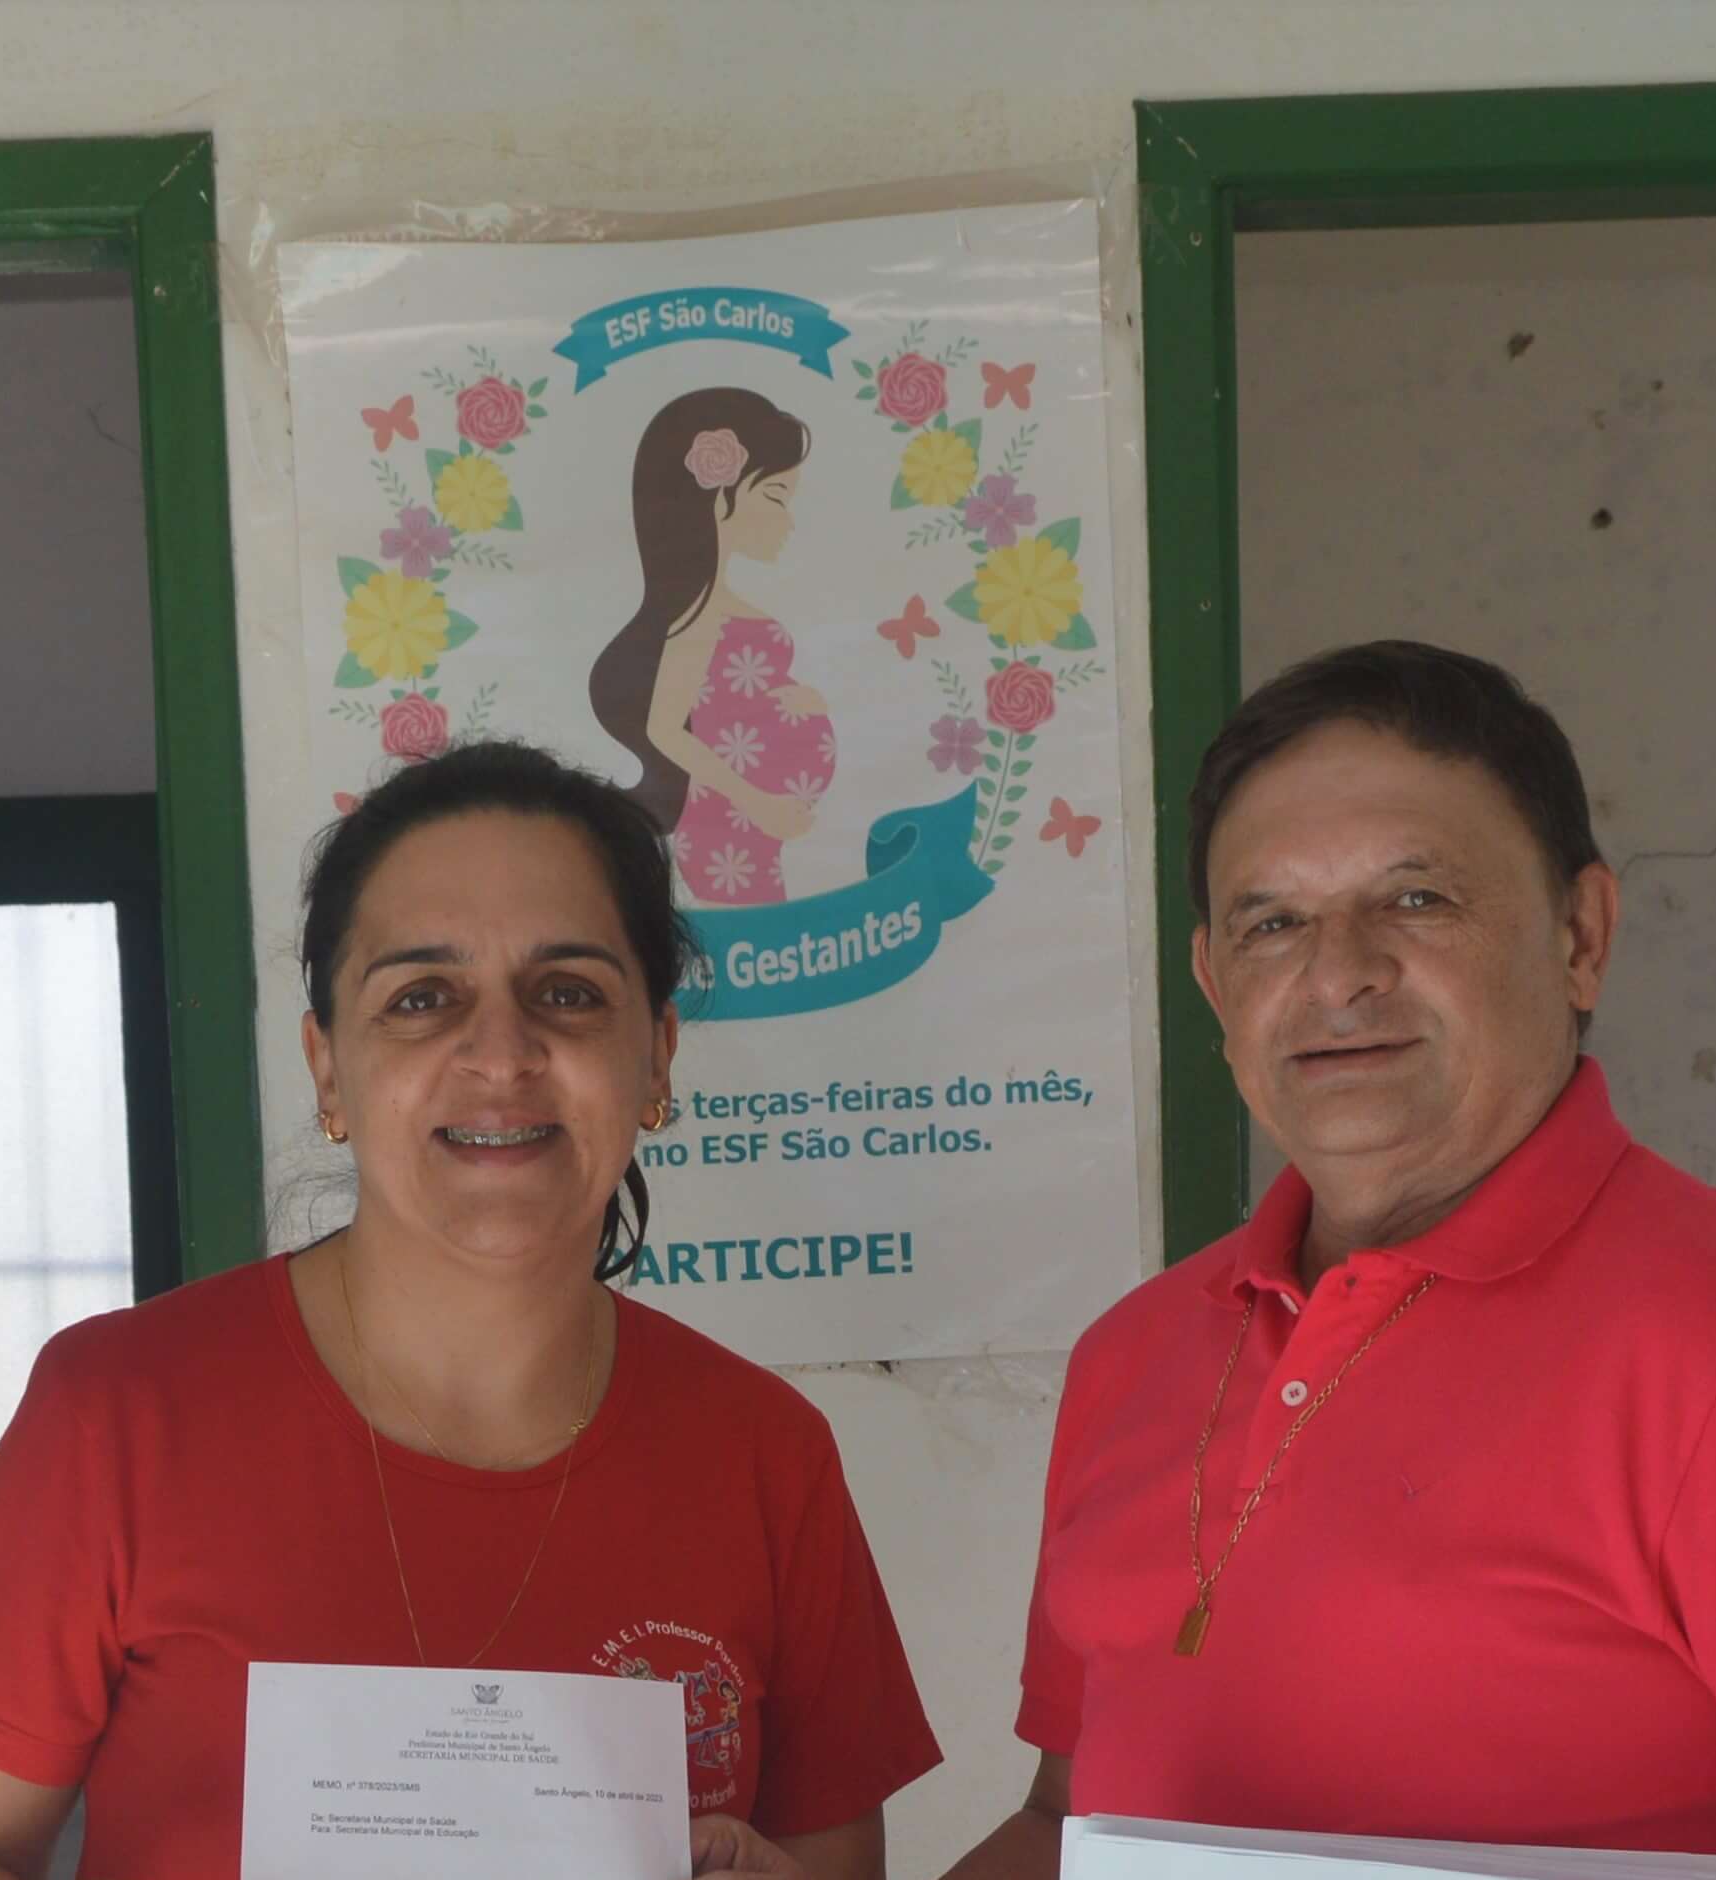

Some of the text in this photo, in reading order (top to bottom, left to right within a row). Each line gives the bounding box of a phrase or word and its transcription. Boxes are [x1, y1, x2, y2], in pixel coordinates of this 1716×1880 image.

[604, 297, 796, 349] ESF São Carlos
[726, 900, 923, 989] Gestantes
[692, 1080, 934, 1124] terças-feiras
[946, 1075, 992, 1107] do
[1005, 1069, 1095, 1109] mês,
[642, 1123, 993, 1168] no ESF São Carlos.
[645, 1620, 714, 1647] Professor
